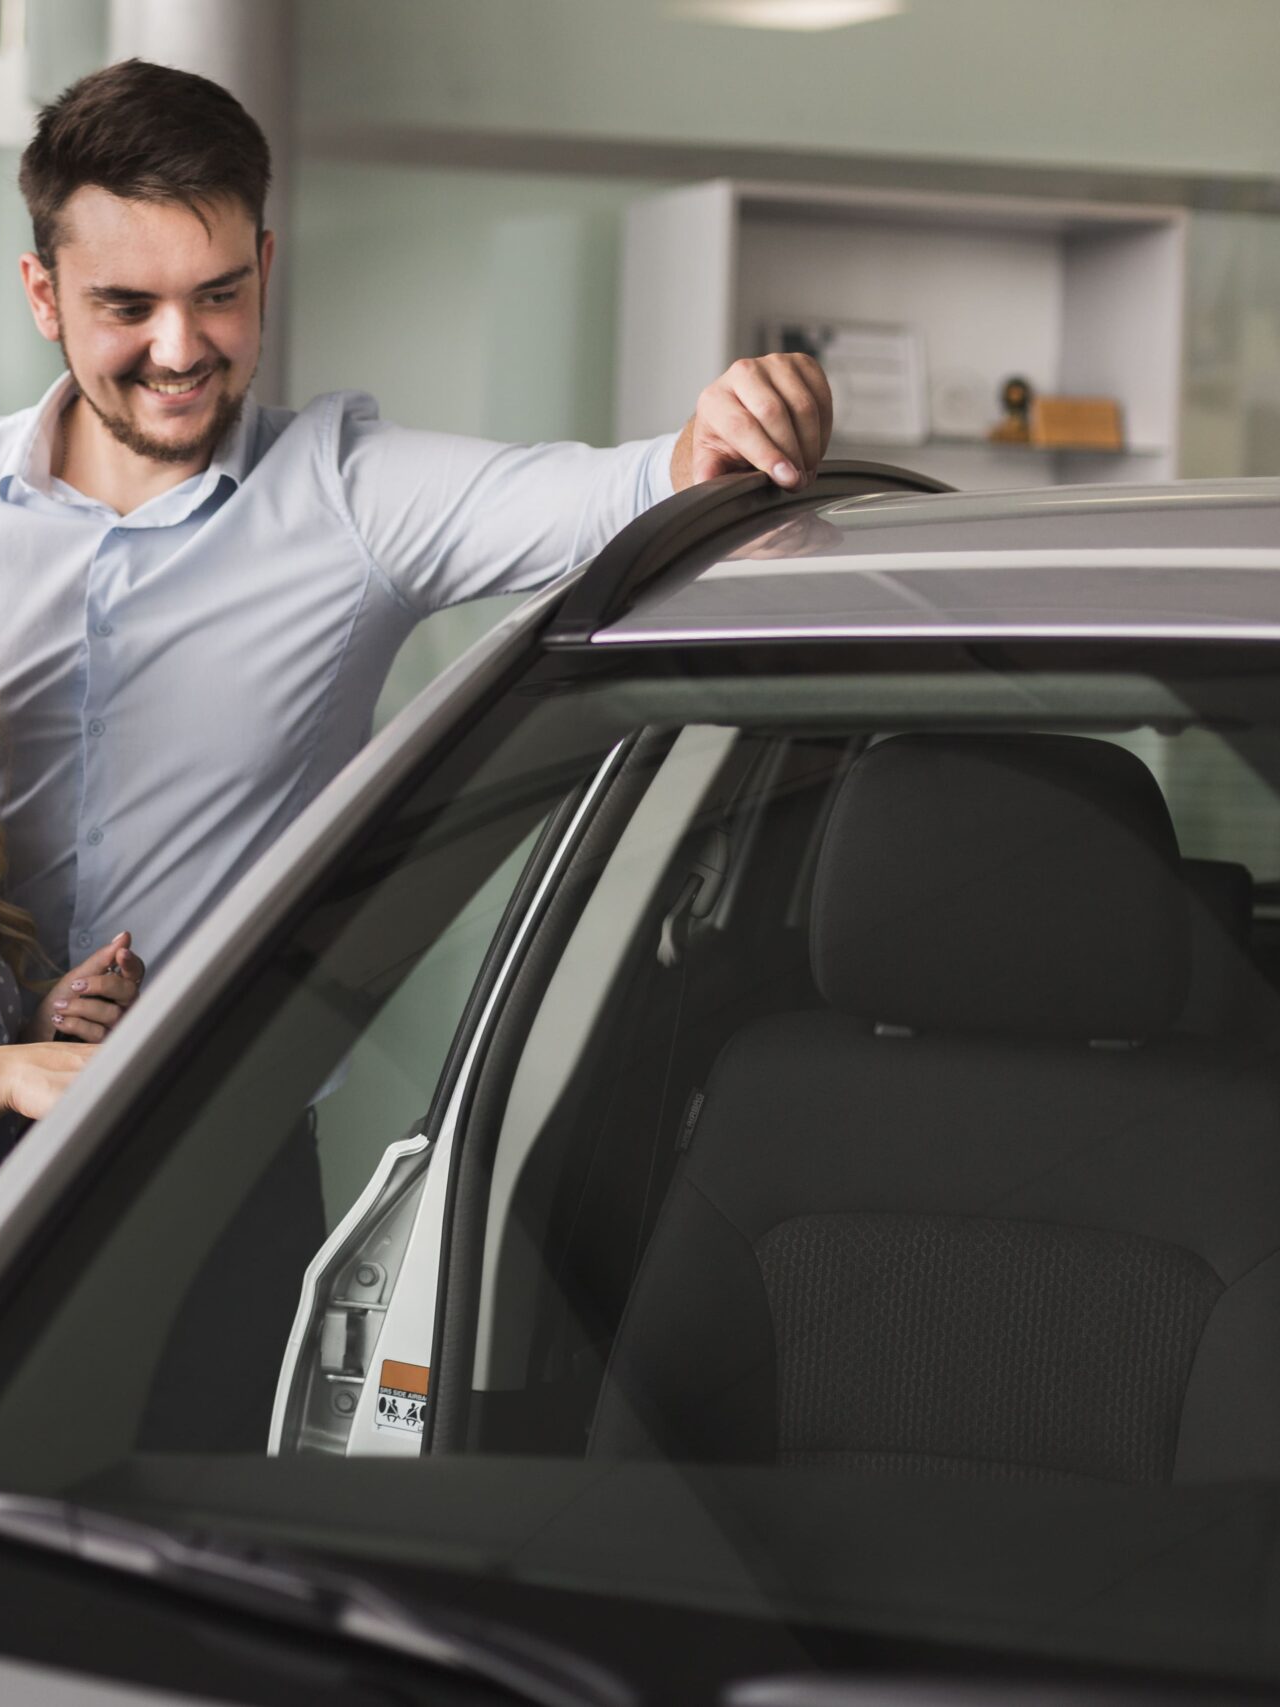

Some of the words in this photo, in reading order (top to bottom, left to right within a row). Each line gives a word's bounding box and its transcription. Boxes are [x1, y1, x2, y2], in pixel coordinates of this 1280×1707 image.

[686, 1093, 705, 1128] AIRBAG
[380, 1387, 393, 1395] SRS
[393, 1389, 407, 1398] SIDE
[407, 1393, 427, 1402] AIRBA
